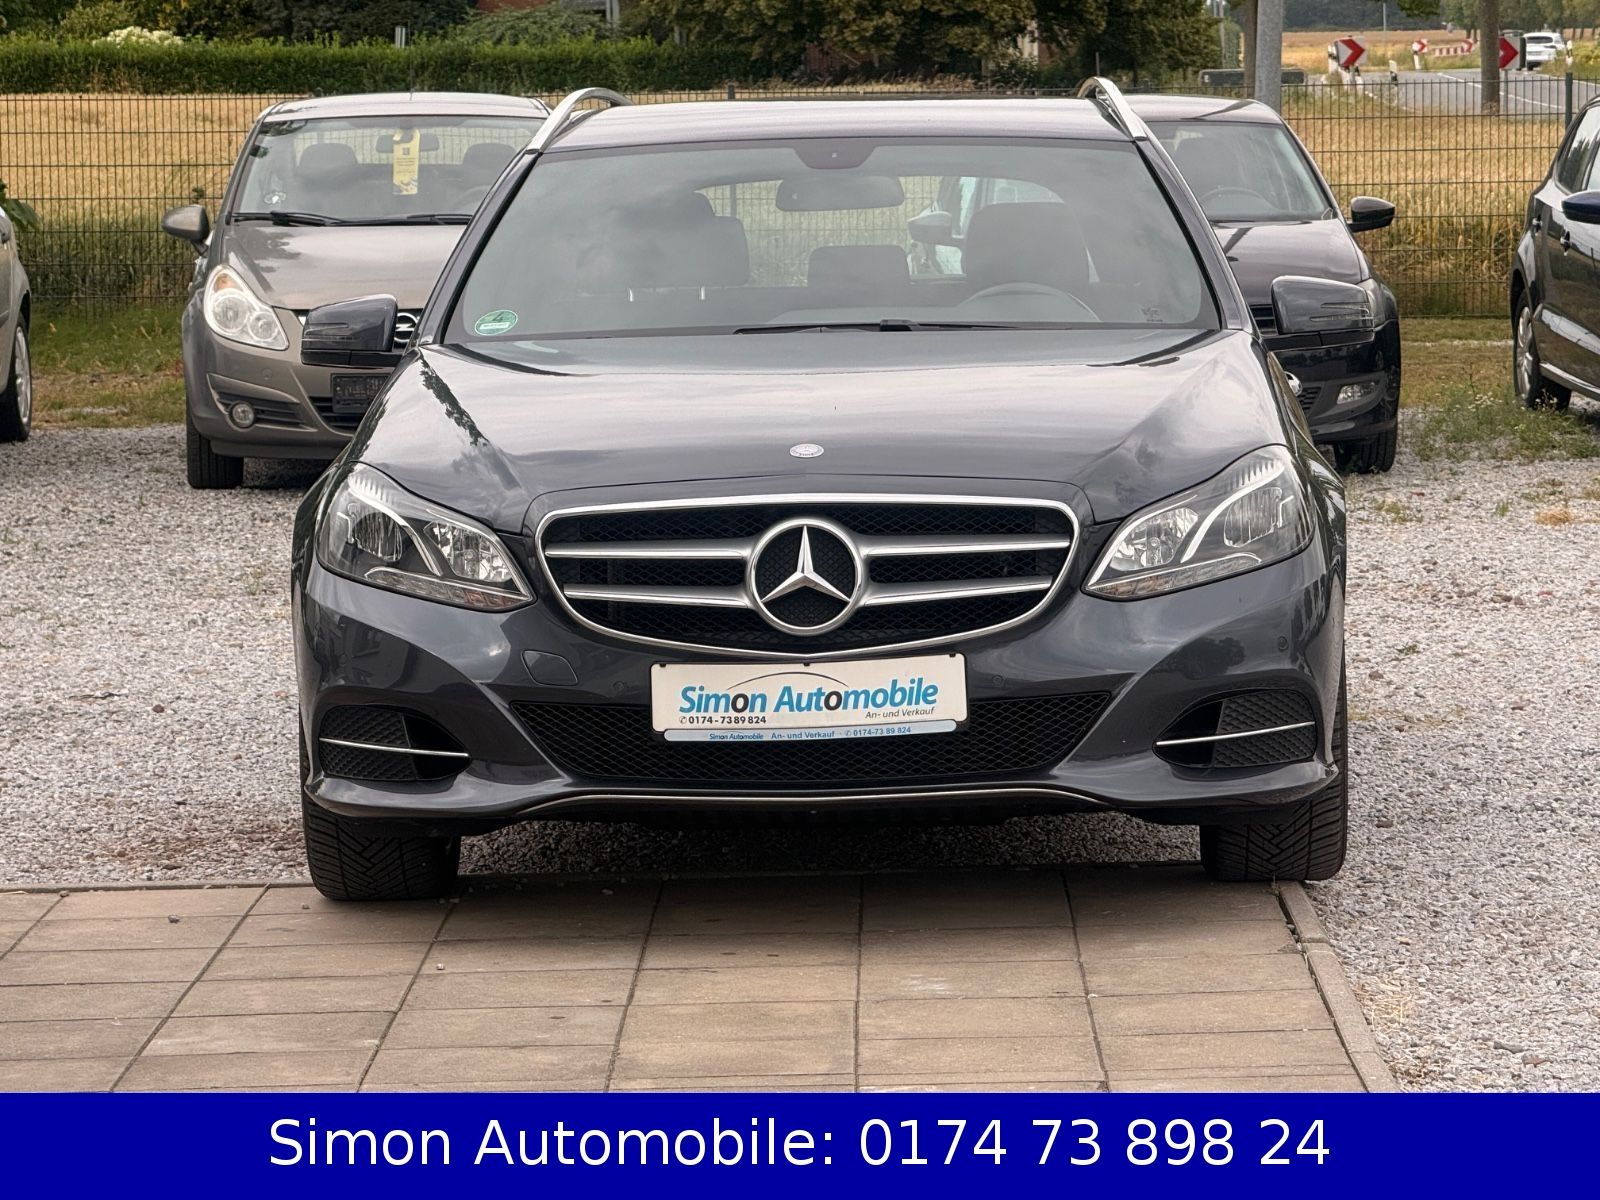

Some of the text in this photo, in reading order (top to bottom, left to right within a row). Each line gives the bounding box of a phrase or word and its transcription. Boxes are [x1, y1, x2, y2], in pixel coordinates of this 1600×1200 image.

[679, 677, 938, 714] Simon Automobile
[865, 707, 935, 719] An- und Verkauf
[729, 732, 764, 740] Automobile
[787, 731, 804, 739] und
[805, 730, 835, 739] Verkauf
